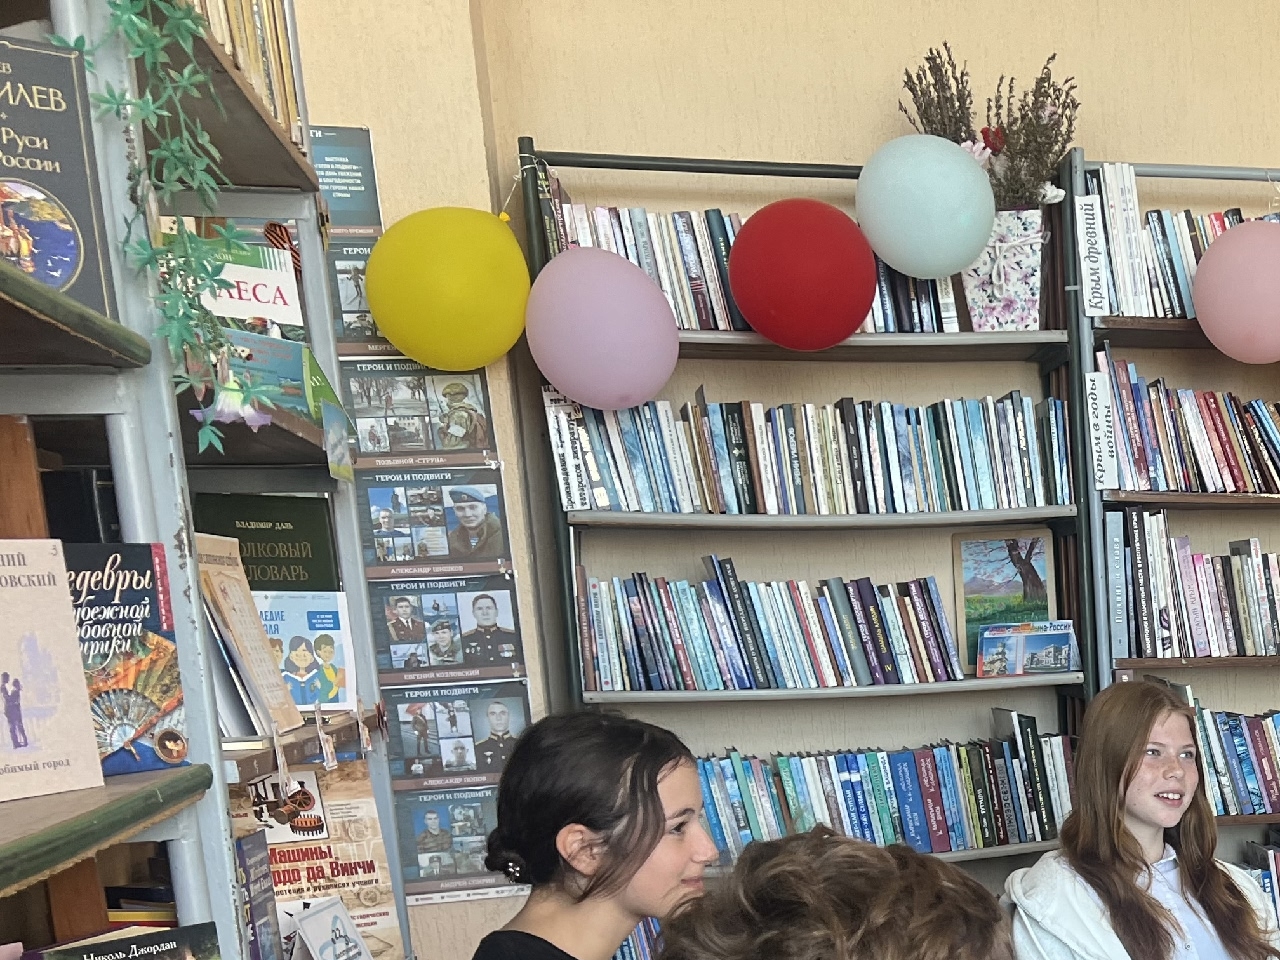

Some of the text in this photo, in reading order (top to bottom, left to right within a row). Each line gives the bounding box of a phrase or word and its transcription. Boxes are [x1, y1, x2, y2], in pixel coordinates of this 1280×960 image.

[1, 127, 48, 153] Руси
[0, 150, 60, 173] оссии
[1080, 202, 1105, 310] Крым древний
[357, 363, 384, 371] ГЕРОИ
[386, 363, 392, 371] И
[1087, 378, 1099, 420] годы
[1103, 405, 1115, 459] войны
[788, 427, 801, 486] ЭРВИН УМЕРОВ
[1095, 436, 1106, 485] Крым
[375, 474, 401, 482] ГЕРОИ
[412, 473, 452, 481] ПОДВИГИ
[275, 522, 293, 530] ДАЛЬ
[243, 564, 309, 580] ЛОВАРЬ
[391, 582, 417, 590] ГЕРОИ
[427, 580, 466, 588] ПОДВИГИ
[405, 687, 479, 698] ГЕРОИ И ПОДВИГИ
[42, 757, 71, 771] город
[419, 793, 444, 802] ГЕРОИ
[454, 790, 492, 799] ПОДВИГИ
[306, 864, 325, 885] да
[330, 859, 376, 879] Винчи
[128, 940, 177, 958] Джордан
